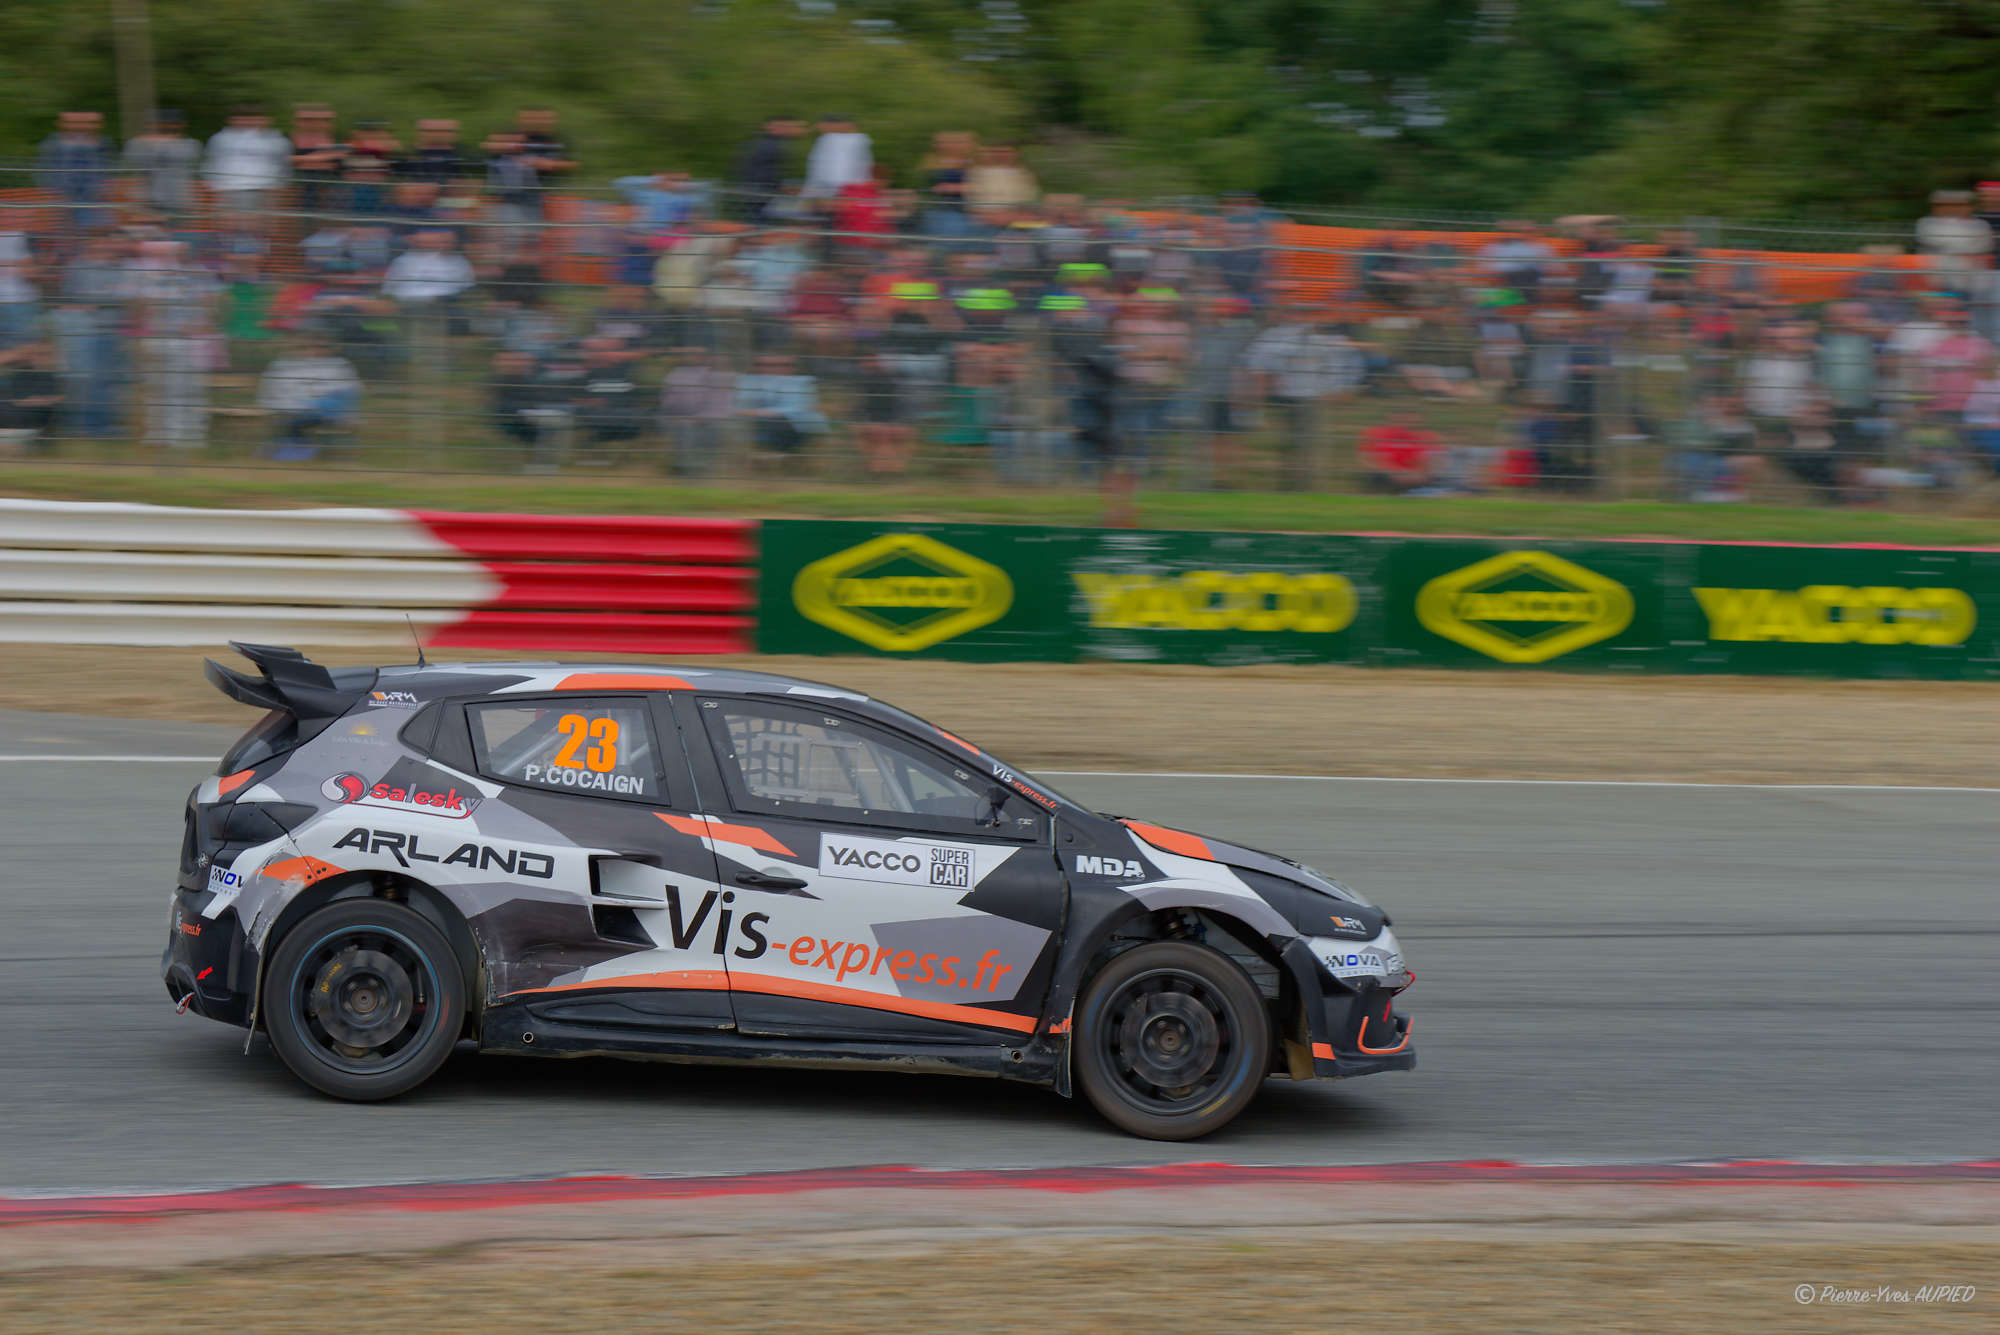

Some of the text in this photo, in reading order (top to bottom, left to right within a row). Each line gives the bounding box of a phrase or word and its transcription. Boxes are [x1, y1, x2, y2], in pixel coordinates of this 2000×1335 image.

[1073, 570, 1357, 632] YACCO
[1692, 584, 1976, 646] YACCO
[554, 714, 619, 773] 23
[524, 764, 644, 794] P.COCAIGN
[369, 783, 484, 812] Salesky
[332, 827, 555, 880] ARLAND
[827, 846, 921, 873] YACCO
[931, 848, 969, 865] SUPER
[1076, 855, 1146, 878] MDA
[930, 862, 968, 888] CAR
[665, 884, 1013, 993] Vis-express.fr
